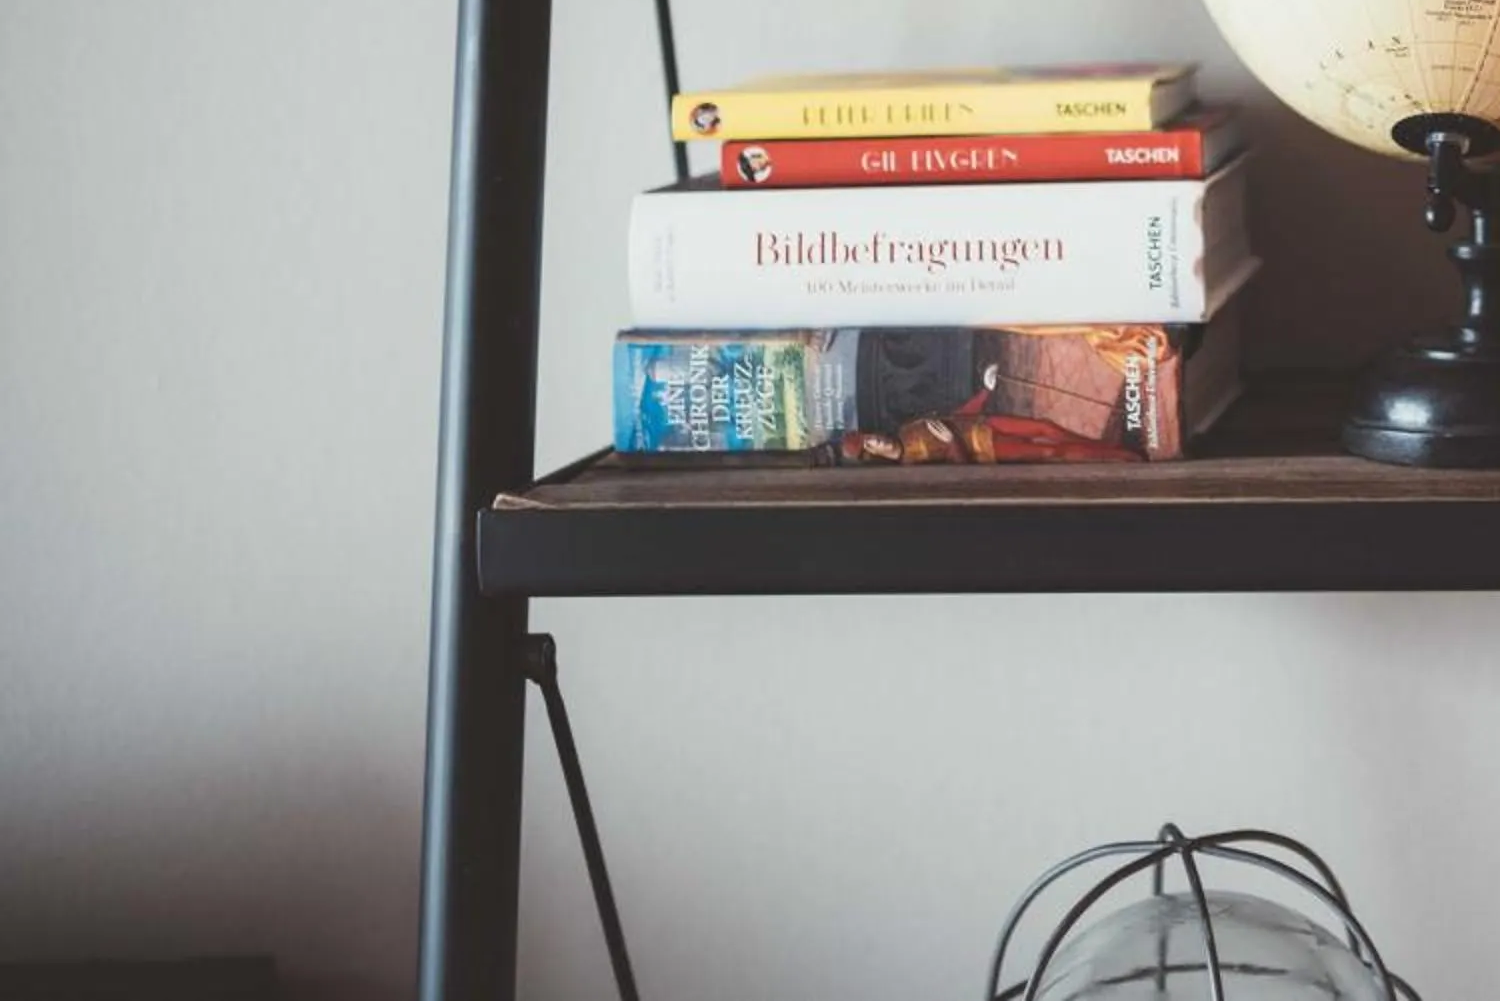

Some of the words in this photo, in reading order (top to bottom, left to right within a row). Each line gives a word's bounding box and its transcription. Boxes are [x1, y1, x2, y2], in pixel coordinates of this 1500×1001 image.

[1055, 101, 1127, 118] TASCHEN
[1104, 146, 1180, 165] TASCHEN
[756, 230, 1065, 274] Bildbefragungen
[1147, 215, 1162, 290] TASCHEN
[666, 372, 686, 427] EINE
[689, 344, 711, 451] CHRONIK
[711, 373, 731, 423] DER
[1124, 353, 1142, 432] TASCHEN
